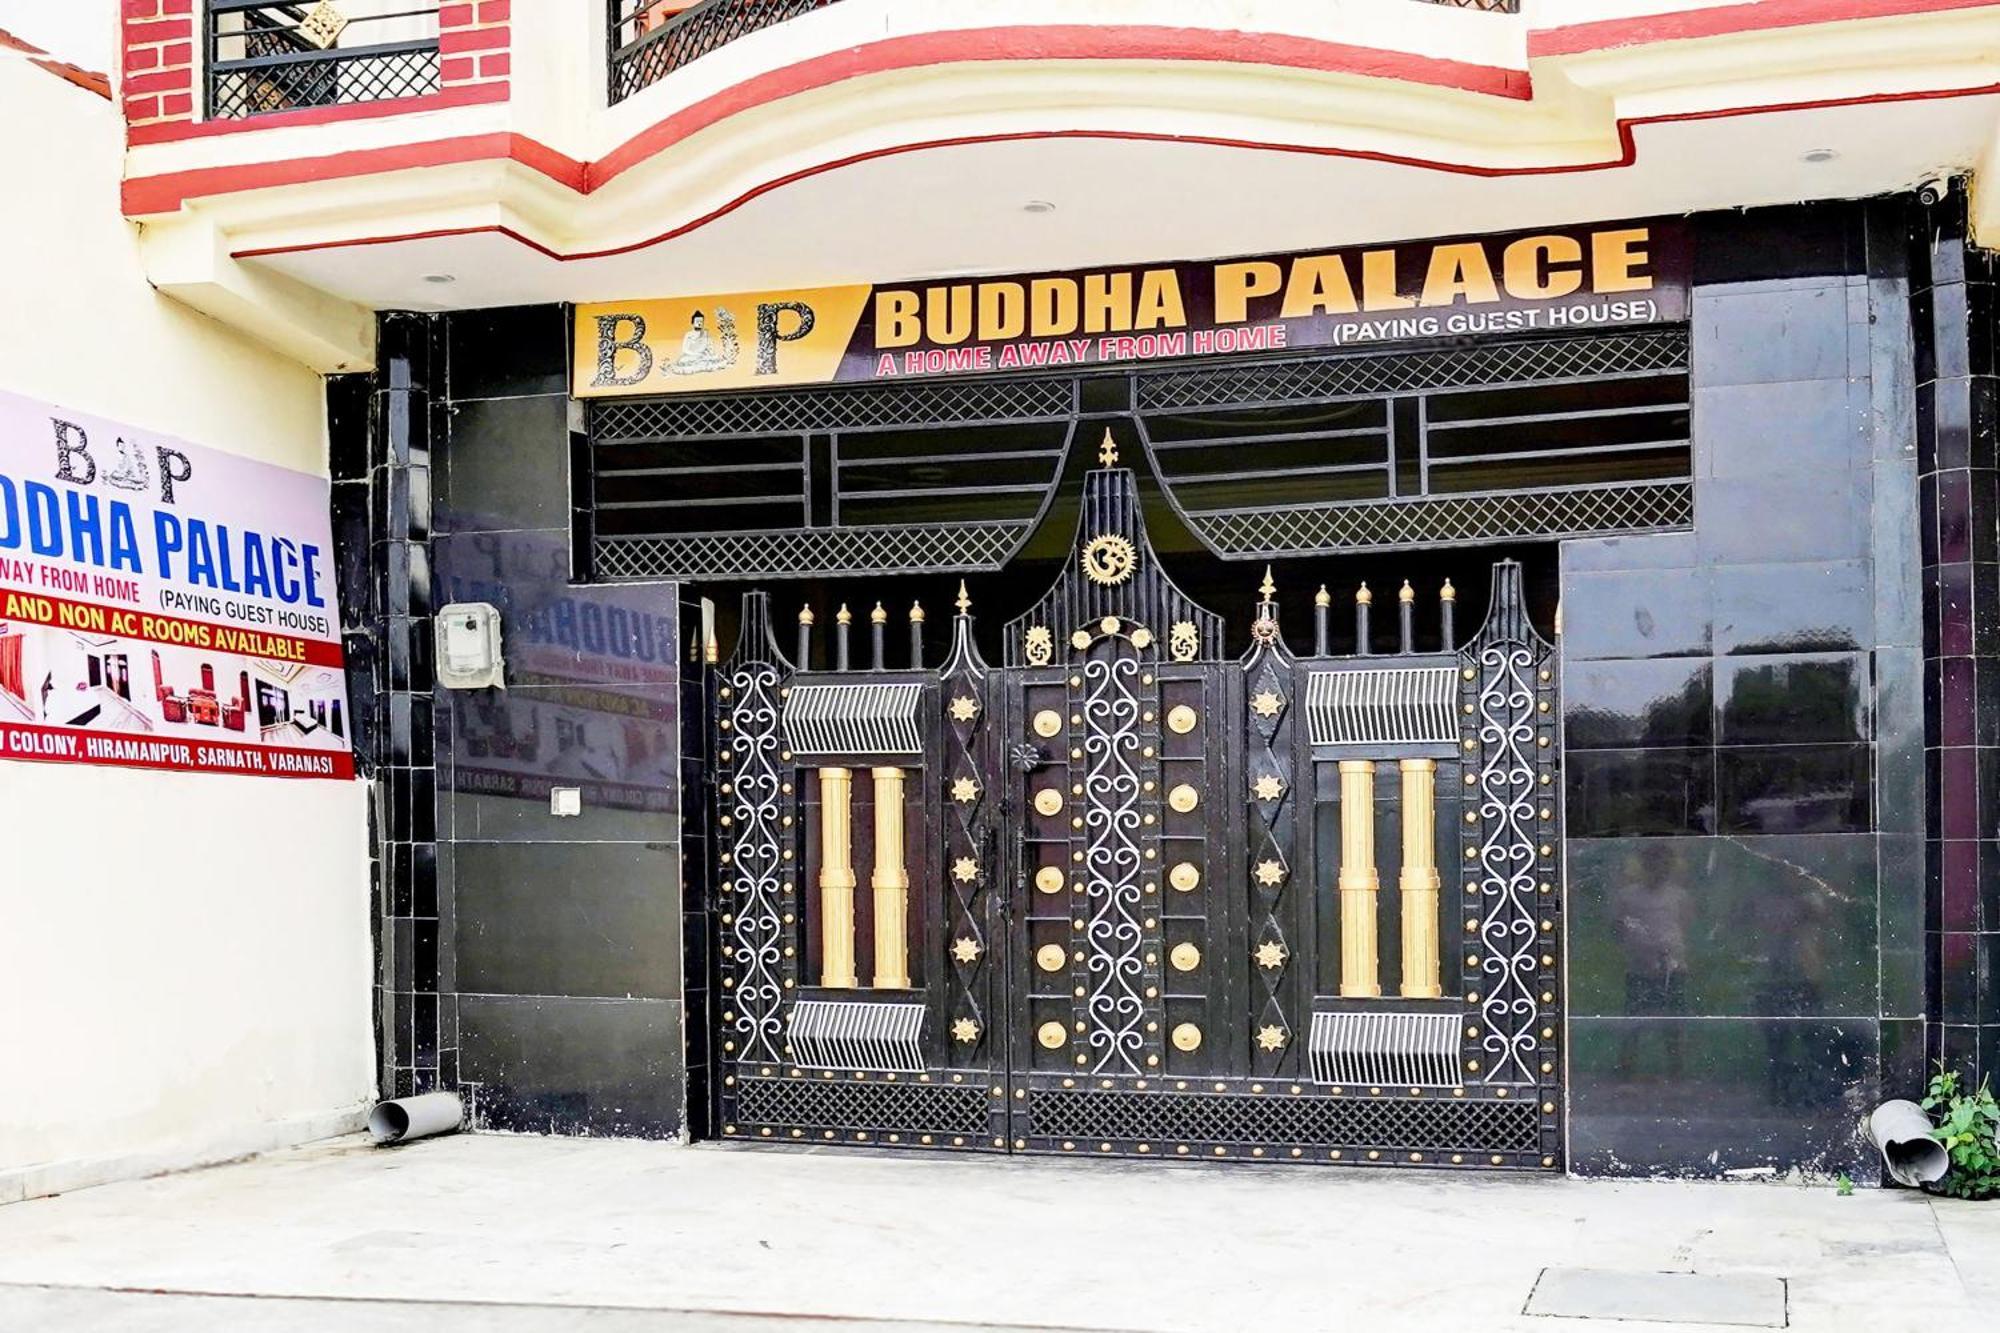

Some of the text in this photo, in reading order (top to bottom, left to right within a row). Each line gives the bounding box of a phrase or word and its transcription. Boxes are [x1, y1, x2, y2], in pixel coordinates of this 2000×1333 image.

[875, 227, 1654, 349] BUDDHA PALACE
[1332, 299, 1658, 346] (PAYING GUEST HOUSE)
[876, 324, 1287, 377] A HOME AWAY FROM HOME
[40, 564, 89, 595] FROM
[93, 575, 141, 603] HOME
[153, 509, 326, 608] PALACE
[6, 594, 306, 661] AND NON AC ROOMS AVAILABLE
[159, 589, 330, 637] (PAYING GUEST HOUSE)
[9, 730, 83, 759] COLONY,
[86, 737, 194, 767] HIRAMANPUR,
[197, 746, 267, 772] SARNATH,
[269, 752, 334, 774] VARANASI
